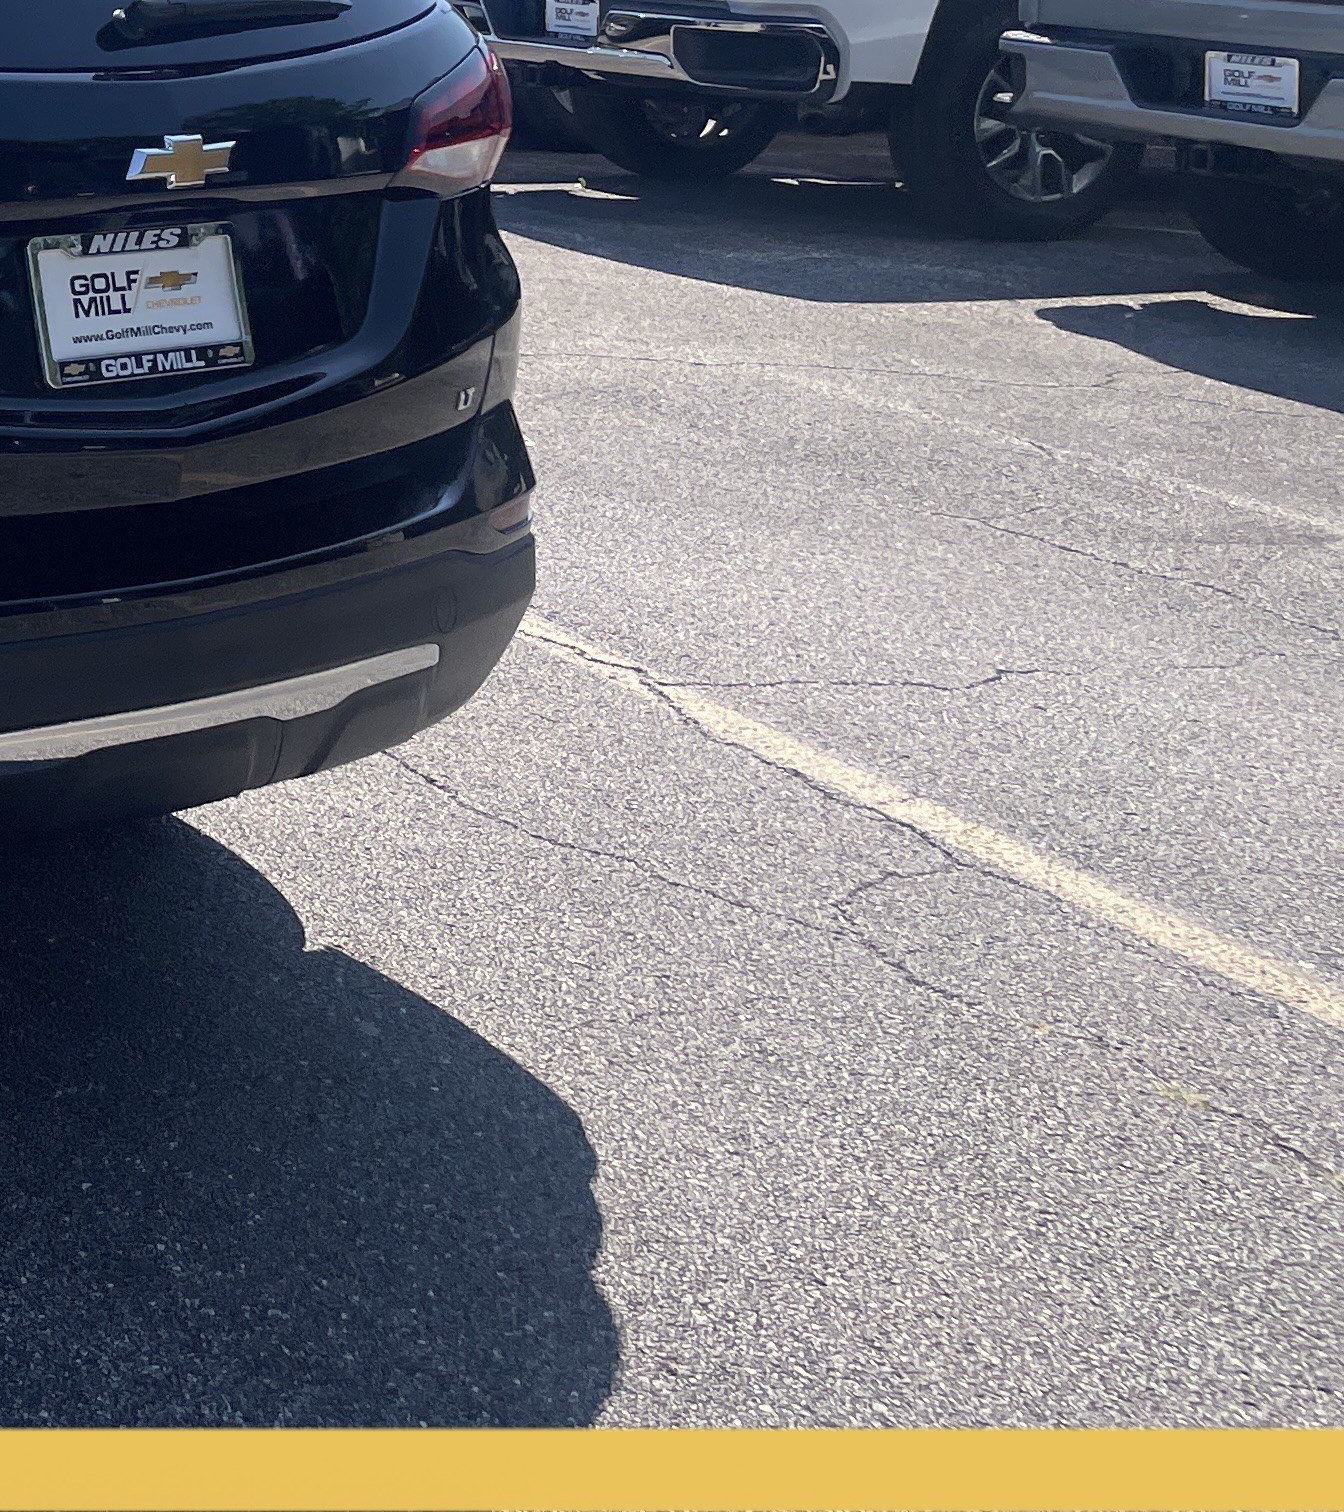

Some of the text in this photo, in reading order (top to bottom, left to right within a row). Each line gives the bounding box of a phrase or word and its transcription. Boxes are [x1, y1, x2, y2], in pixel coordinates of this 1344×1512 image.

[1223, 69, 1255, 79] GOLF
[88, 227, 182, 255] NILES
[69, 269, 141, 296] GOLF
[72, 293, 132, 319] MILL
[71, 320, 214, 345] www.GolfMillChevy.com
[100, 349, 205, 378] GOLF MILL
[457, 387, 475, 411] LT
